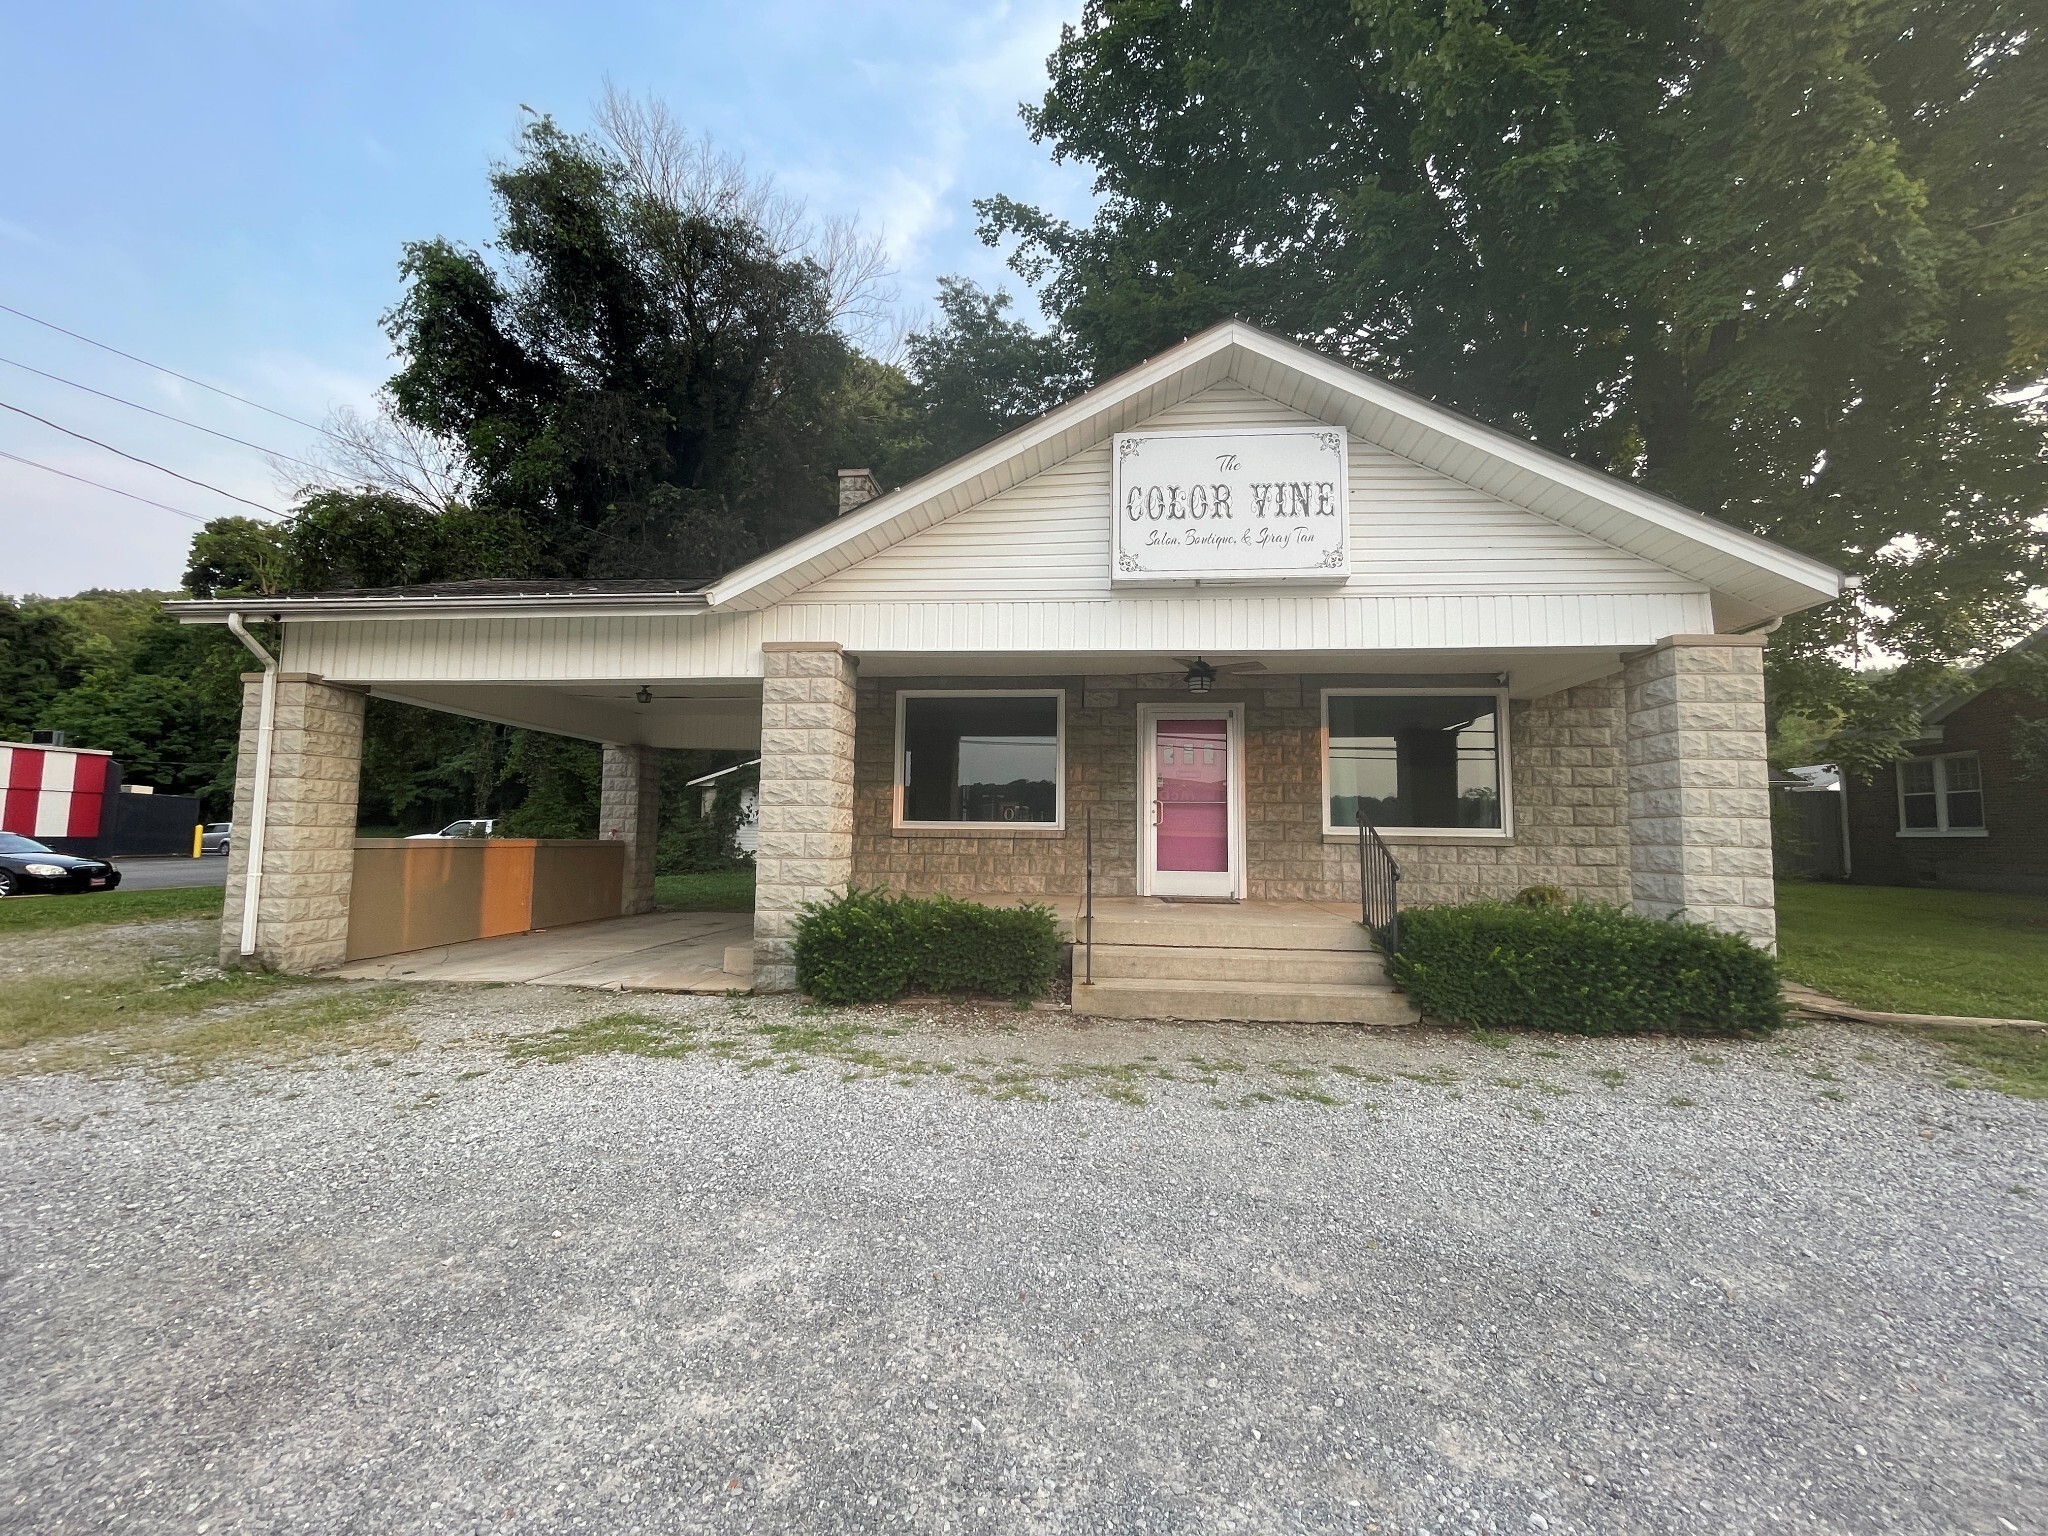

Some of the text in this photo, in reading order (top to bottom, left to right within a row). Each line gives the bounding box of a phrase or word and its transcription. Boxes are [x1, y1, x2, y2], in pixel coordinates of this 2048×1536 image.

[1216, 454, 1242, 473] The
[1126, 481, 1335, 522] COLOR VINE
[1241, 528, 1252, 547] &
[1255, 527, 1292, 550] Spray
[1293, 526, 1315, 544] Tan
